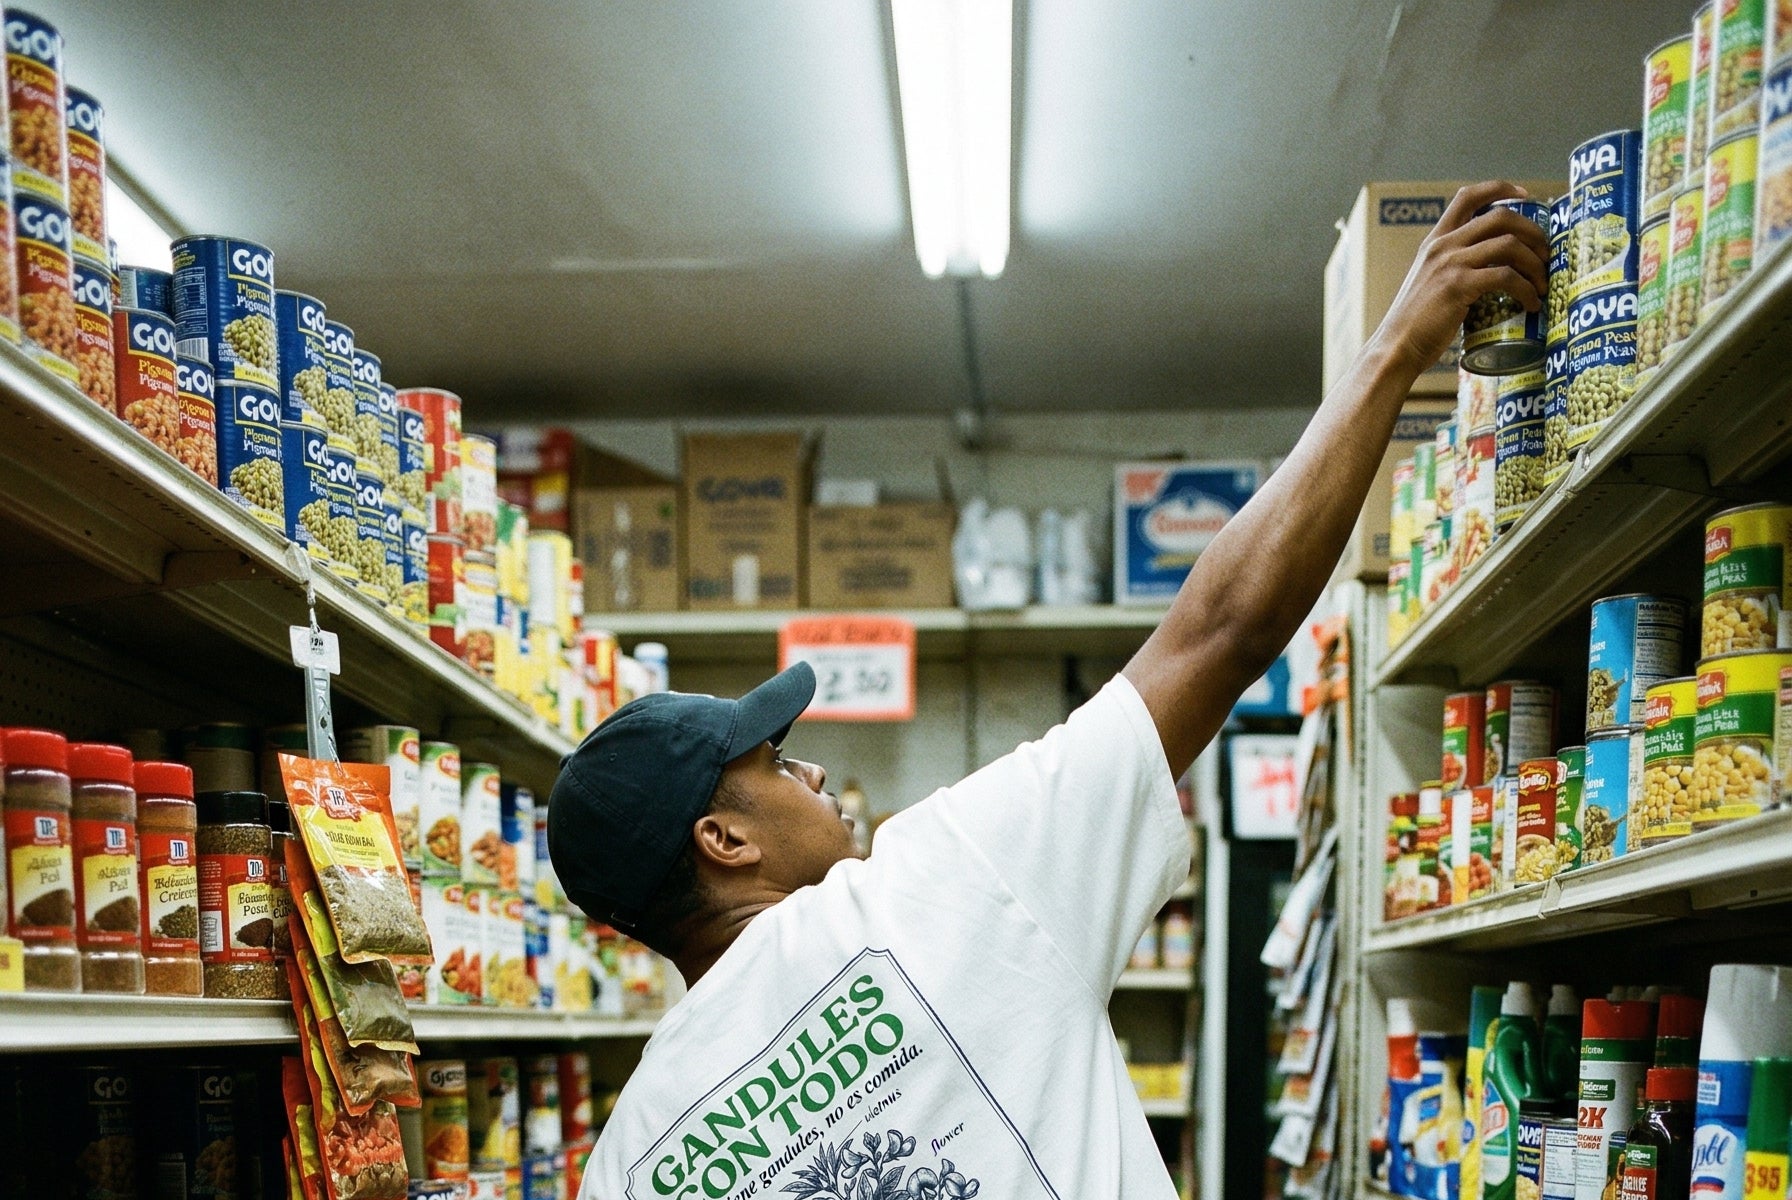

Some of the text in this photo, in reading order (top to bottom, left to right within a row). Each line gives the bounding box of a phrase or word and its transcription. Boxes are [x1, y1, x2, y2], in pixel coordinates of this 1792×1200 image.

[1570, 292, 1637, 335] GOYA
[652, 975, 884, 1195] GANDULES
[759, 1127, 825, 1189] gandules,
[825, 1106, 844, 1128] no
[847, 1090, 862, 1109] es
[864, 1044, 924, 1094] comida.
[769, 1013, 904, 1136] TODO
